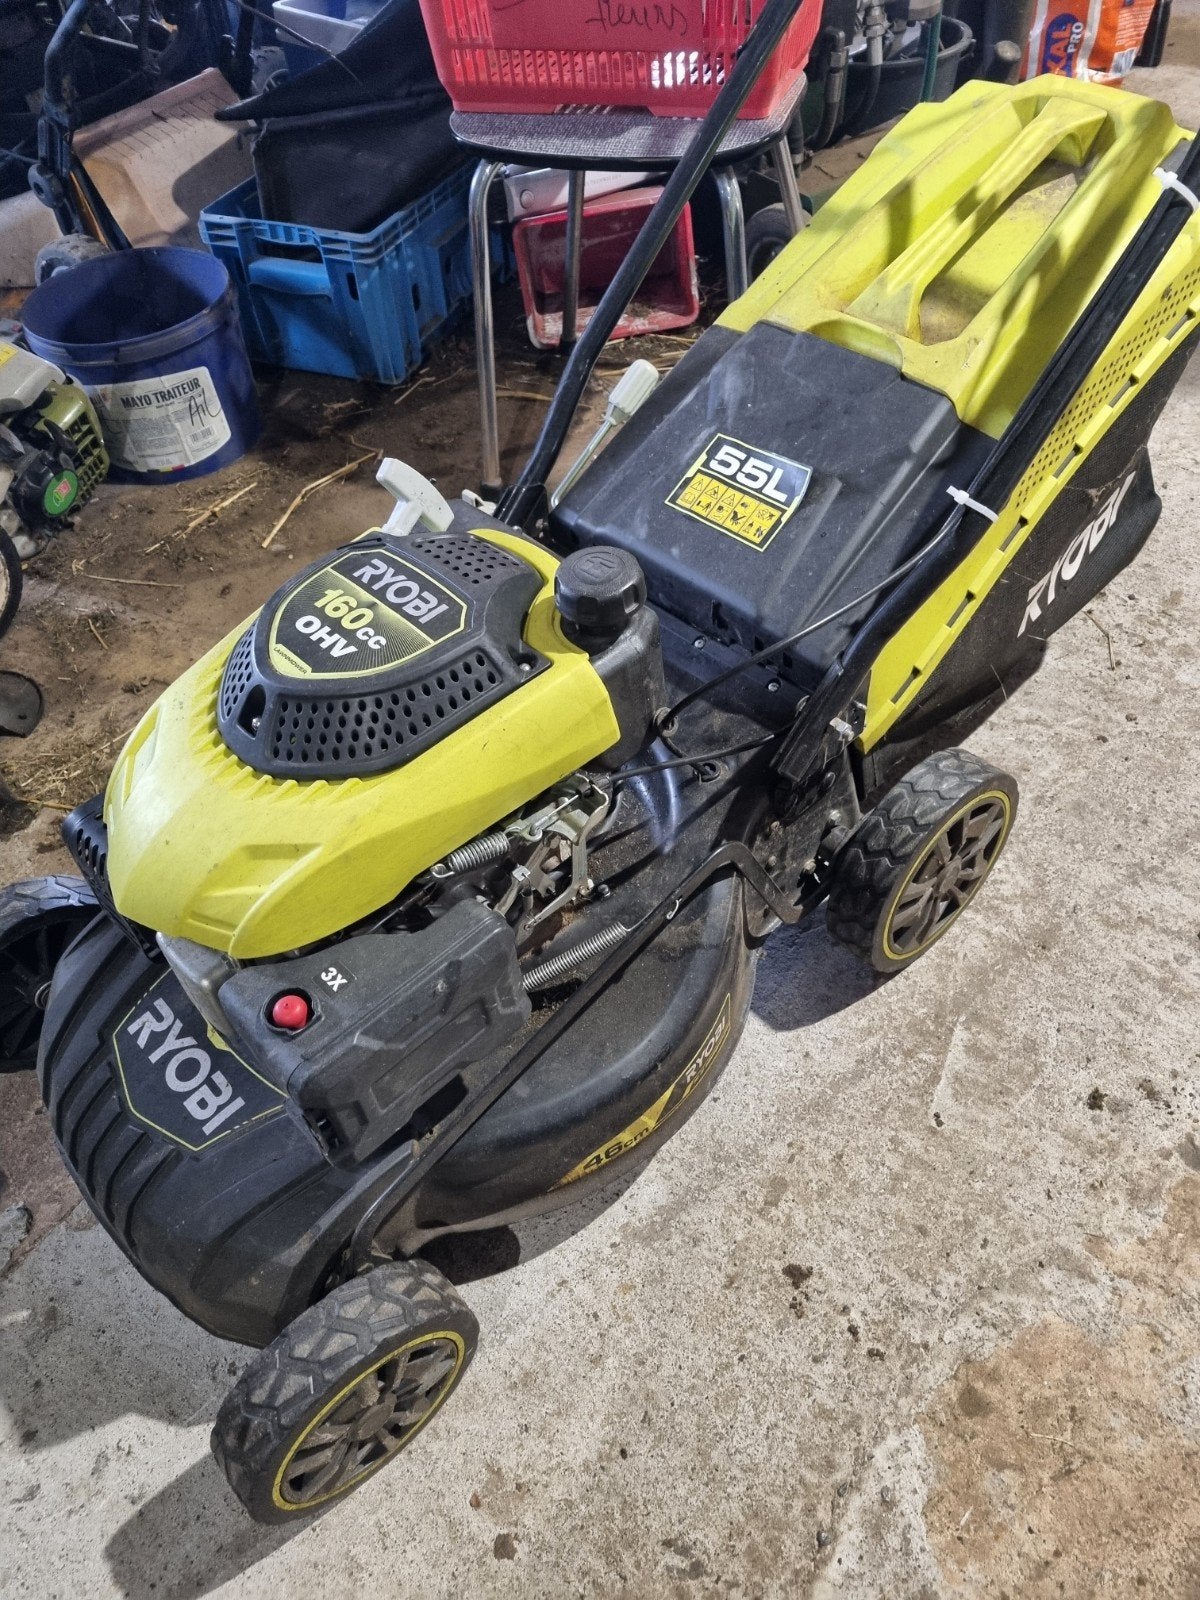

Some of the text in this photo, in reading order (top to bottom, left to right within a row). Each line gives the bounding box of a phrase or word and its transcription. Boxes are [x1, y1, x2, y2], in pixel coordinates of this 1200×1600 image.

[1066, 22, 1084, 54] PRO
[120, 393, 153, 409] MAYO
[153, 377, 201, 403] TRAITEUR
[708, 444, 788, 503] 55L
[1016, 470, 1136, 638] RYOBI
[352, 558, 450, 624] RYOBI
[295, 614, 359, 658] OHV
[320, 966, 348, 993] 3X
[126, 997, 246, 1136] RYOBI
[684, 1016, 726, 1083] RYOBI
